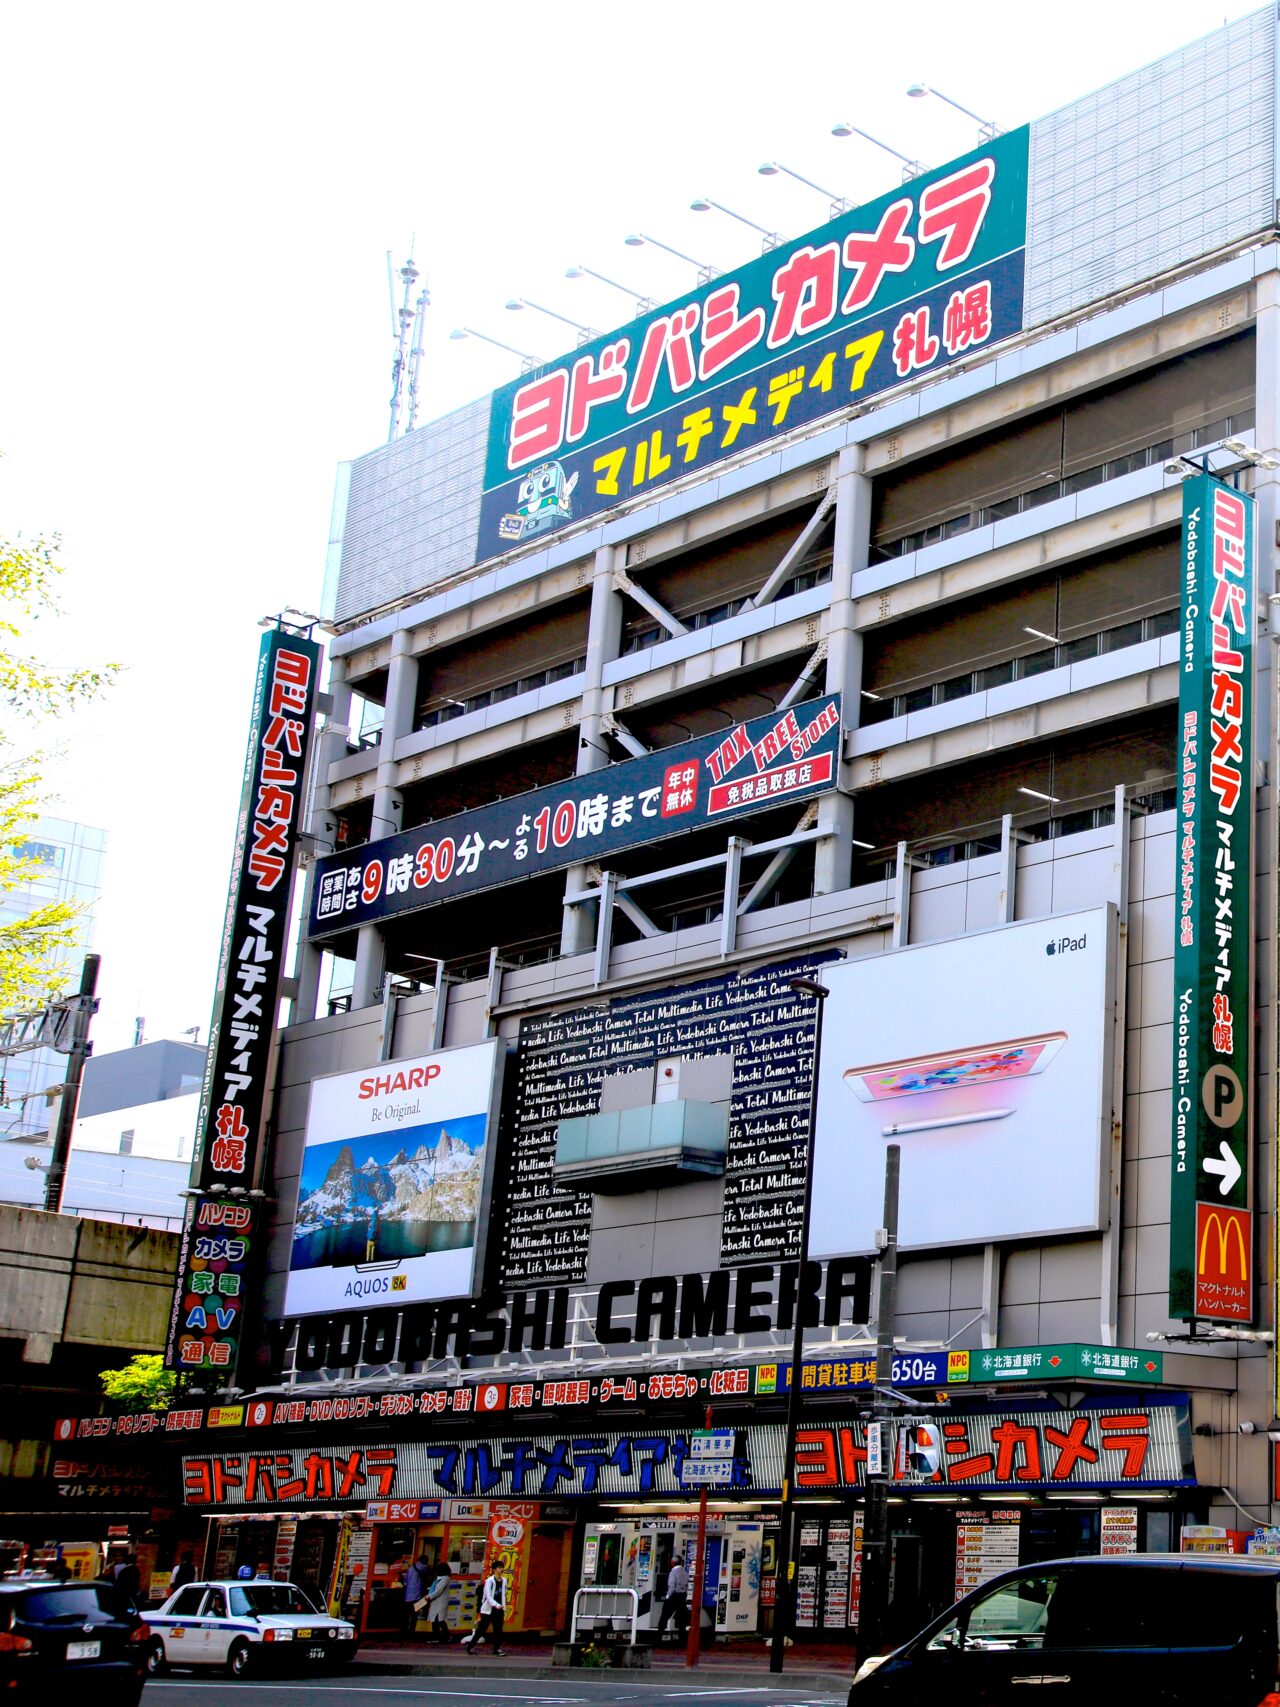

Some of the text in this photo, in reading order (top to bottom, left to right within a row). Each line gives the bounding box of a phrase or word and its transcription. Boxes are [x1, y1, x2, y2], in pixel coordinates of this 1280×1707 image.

[508, 157, 995, 470] ヨドバシカメラ
[593, 281, 992, 496] マルチメディア札幌
[1184, 507, 1201, 673] Yodobashi-Camera
[705, 701, 840, 785] TAX FREE STORE
[669, 767, 695, 789] 年中
[1182, 711, 1197, 818] ヨドバシカメラ
[1210, 487, 1245, 1055] ヨドバシカメラ マルチメディア札幌
[727, 764, 812, 805] 免税品取扱店
[666, 788, 693, 811] 無休
[323, 874, 344, 894] 営業
[211, 648, 311, 1174] ヨドバシカメラ マルチメディア札幌
[321, 892, 342, 913] 時間
[1058, 933, 1087, 954] iPad
[634, 1011, 654, 1024] Total
[706, 994, 723, 1010] Life
[588, 1045, 608, 1059] Total
[657, 1031, 674, 1046] Life
[751, 1010, 774, 1026] Total
[358, 1064, 441, 1100] SHARP
[541, 1104, 557, 1118] Life
[765, 1064, 796, 1078] Camera
[569, 1074, 585, 1088] Life
[1176, 989, 1193, 1174] Yodobashi-Camera
[745, 1093, 768, 1108] Total
[1214, 1074, 1235, 1118] P
[371, 1099, 421, 1123] Be Original.
[745, 1118, 788, 1136] Yodobashi
[534, 1151, 791, 1198] Life Camera
[545, 1177, 763, 1219] Camera Total
[199, 1203, 250, 1227] パソコン
[554, 1231, 571, 1245] Life
[739, 1203, 783, 1220] Yodobashi
[195, 1237, 245, 1261] カメラ
[527, 1260, 543, 1274] Life
[754, 1234, 785, 1247] Camera
[192, 1272, 240, 1296] 家電
[345, 1277, 389, 1298] AQUOS
[599, 1259, 873, 1345] CAMERA
[182, 1341, 231, 1365] 通信
[950, 1354, 967, 1367] NPC
[993, 1353, 1042, 1368] 北海道銀行
[1092, 1353, 1139, 1369] 北海道銀行
[760, 1367, 775, 1379] NPC
[184, 1449, 397, 1504] ヨドバシカメラ
[685, 1464, 720, 1476] 北海道大学
[390, 1503, 417, 1519] 宝くじ
